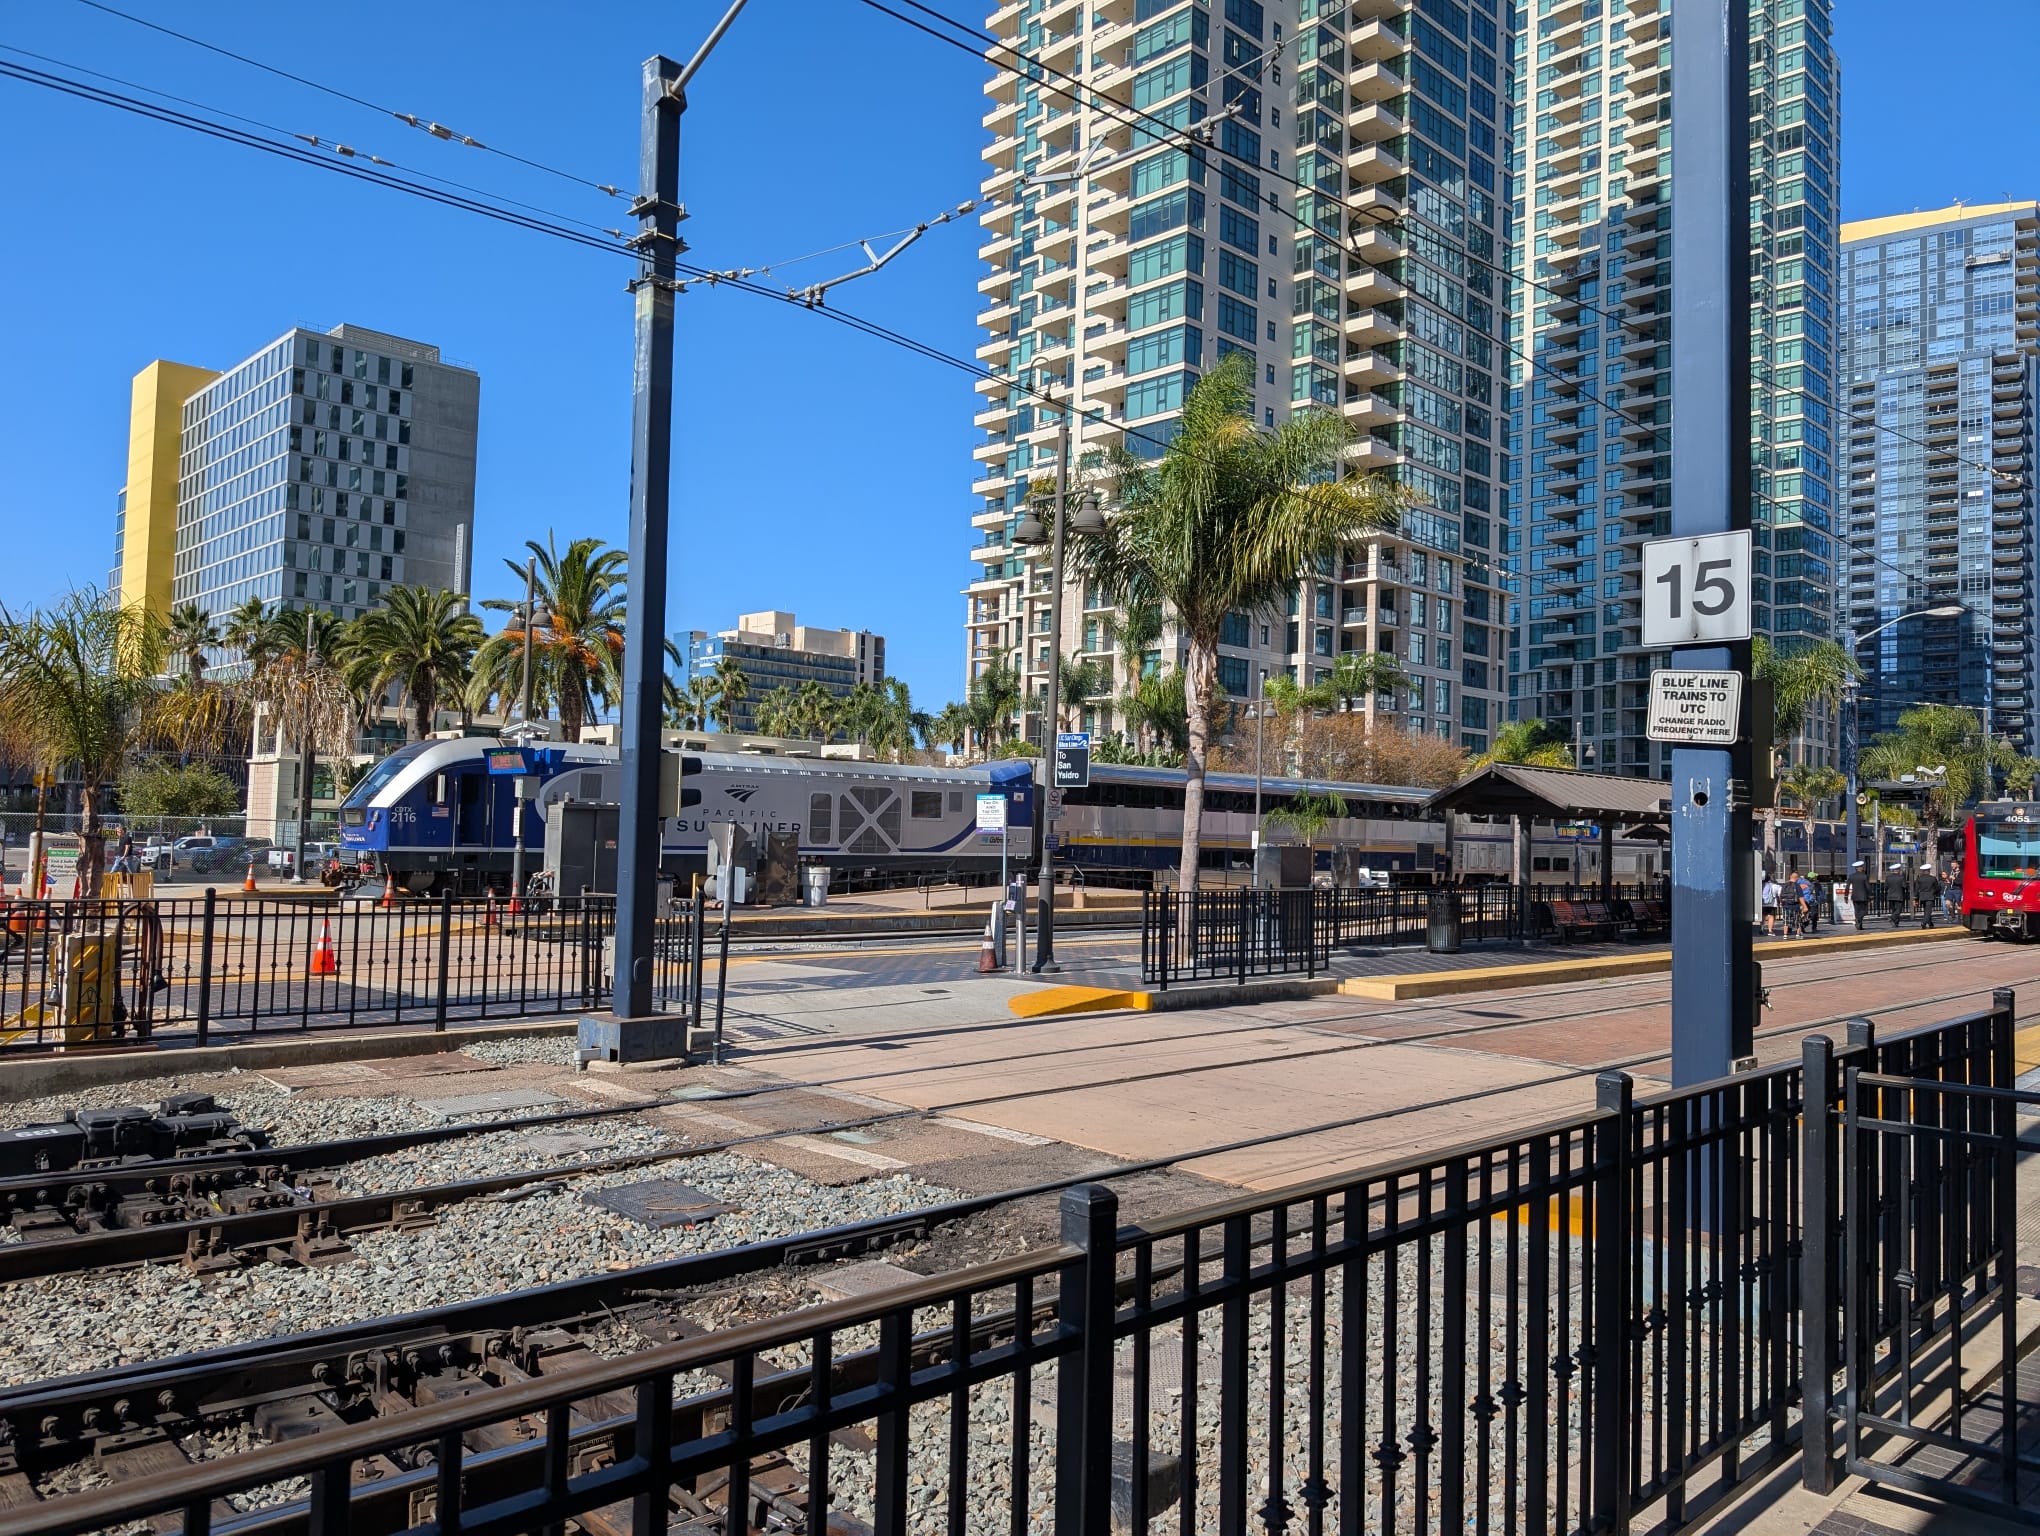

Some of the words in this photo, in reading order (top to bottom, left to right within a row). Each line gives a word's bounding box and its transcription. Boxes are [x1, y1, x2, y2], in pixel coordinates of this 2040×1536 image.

[1656, 558, 1735, 619] 15
[1662, 677, 1695, 688] BLUE
[1699, 678, 1729, 689] LINE
[1662, 690, 1708, 701] TRAINS
[1709, 692, 1727, 702] TO
[1680, 703, 1706, 714] UTC
[1658, 716, 1696, 725] CHANGE
[1697, 718, 1726, 726] RADIO
[1652, 725, 1705, 735] FREQUENCY
[1706, 728, 1731, 736] HERE
[1058, 751, 1067, 760] To
[1057, 761, 1072, 769] San
[1057, 770, 1080, 779] Ysidro
[390, 812, 417, 823] 2116
[702, 808, 777, 818] PACIFIC
[2004, 815, 2030, 823] 4055
[676, 819, 801, 833] SUINER
